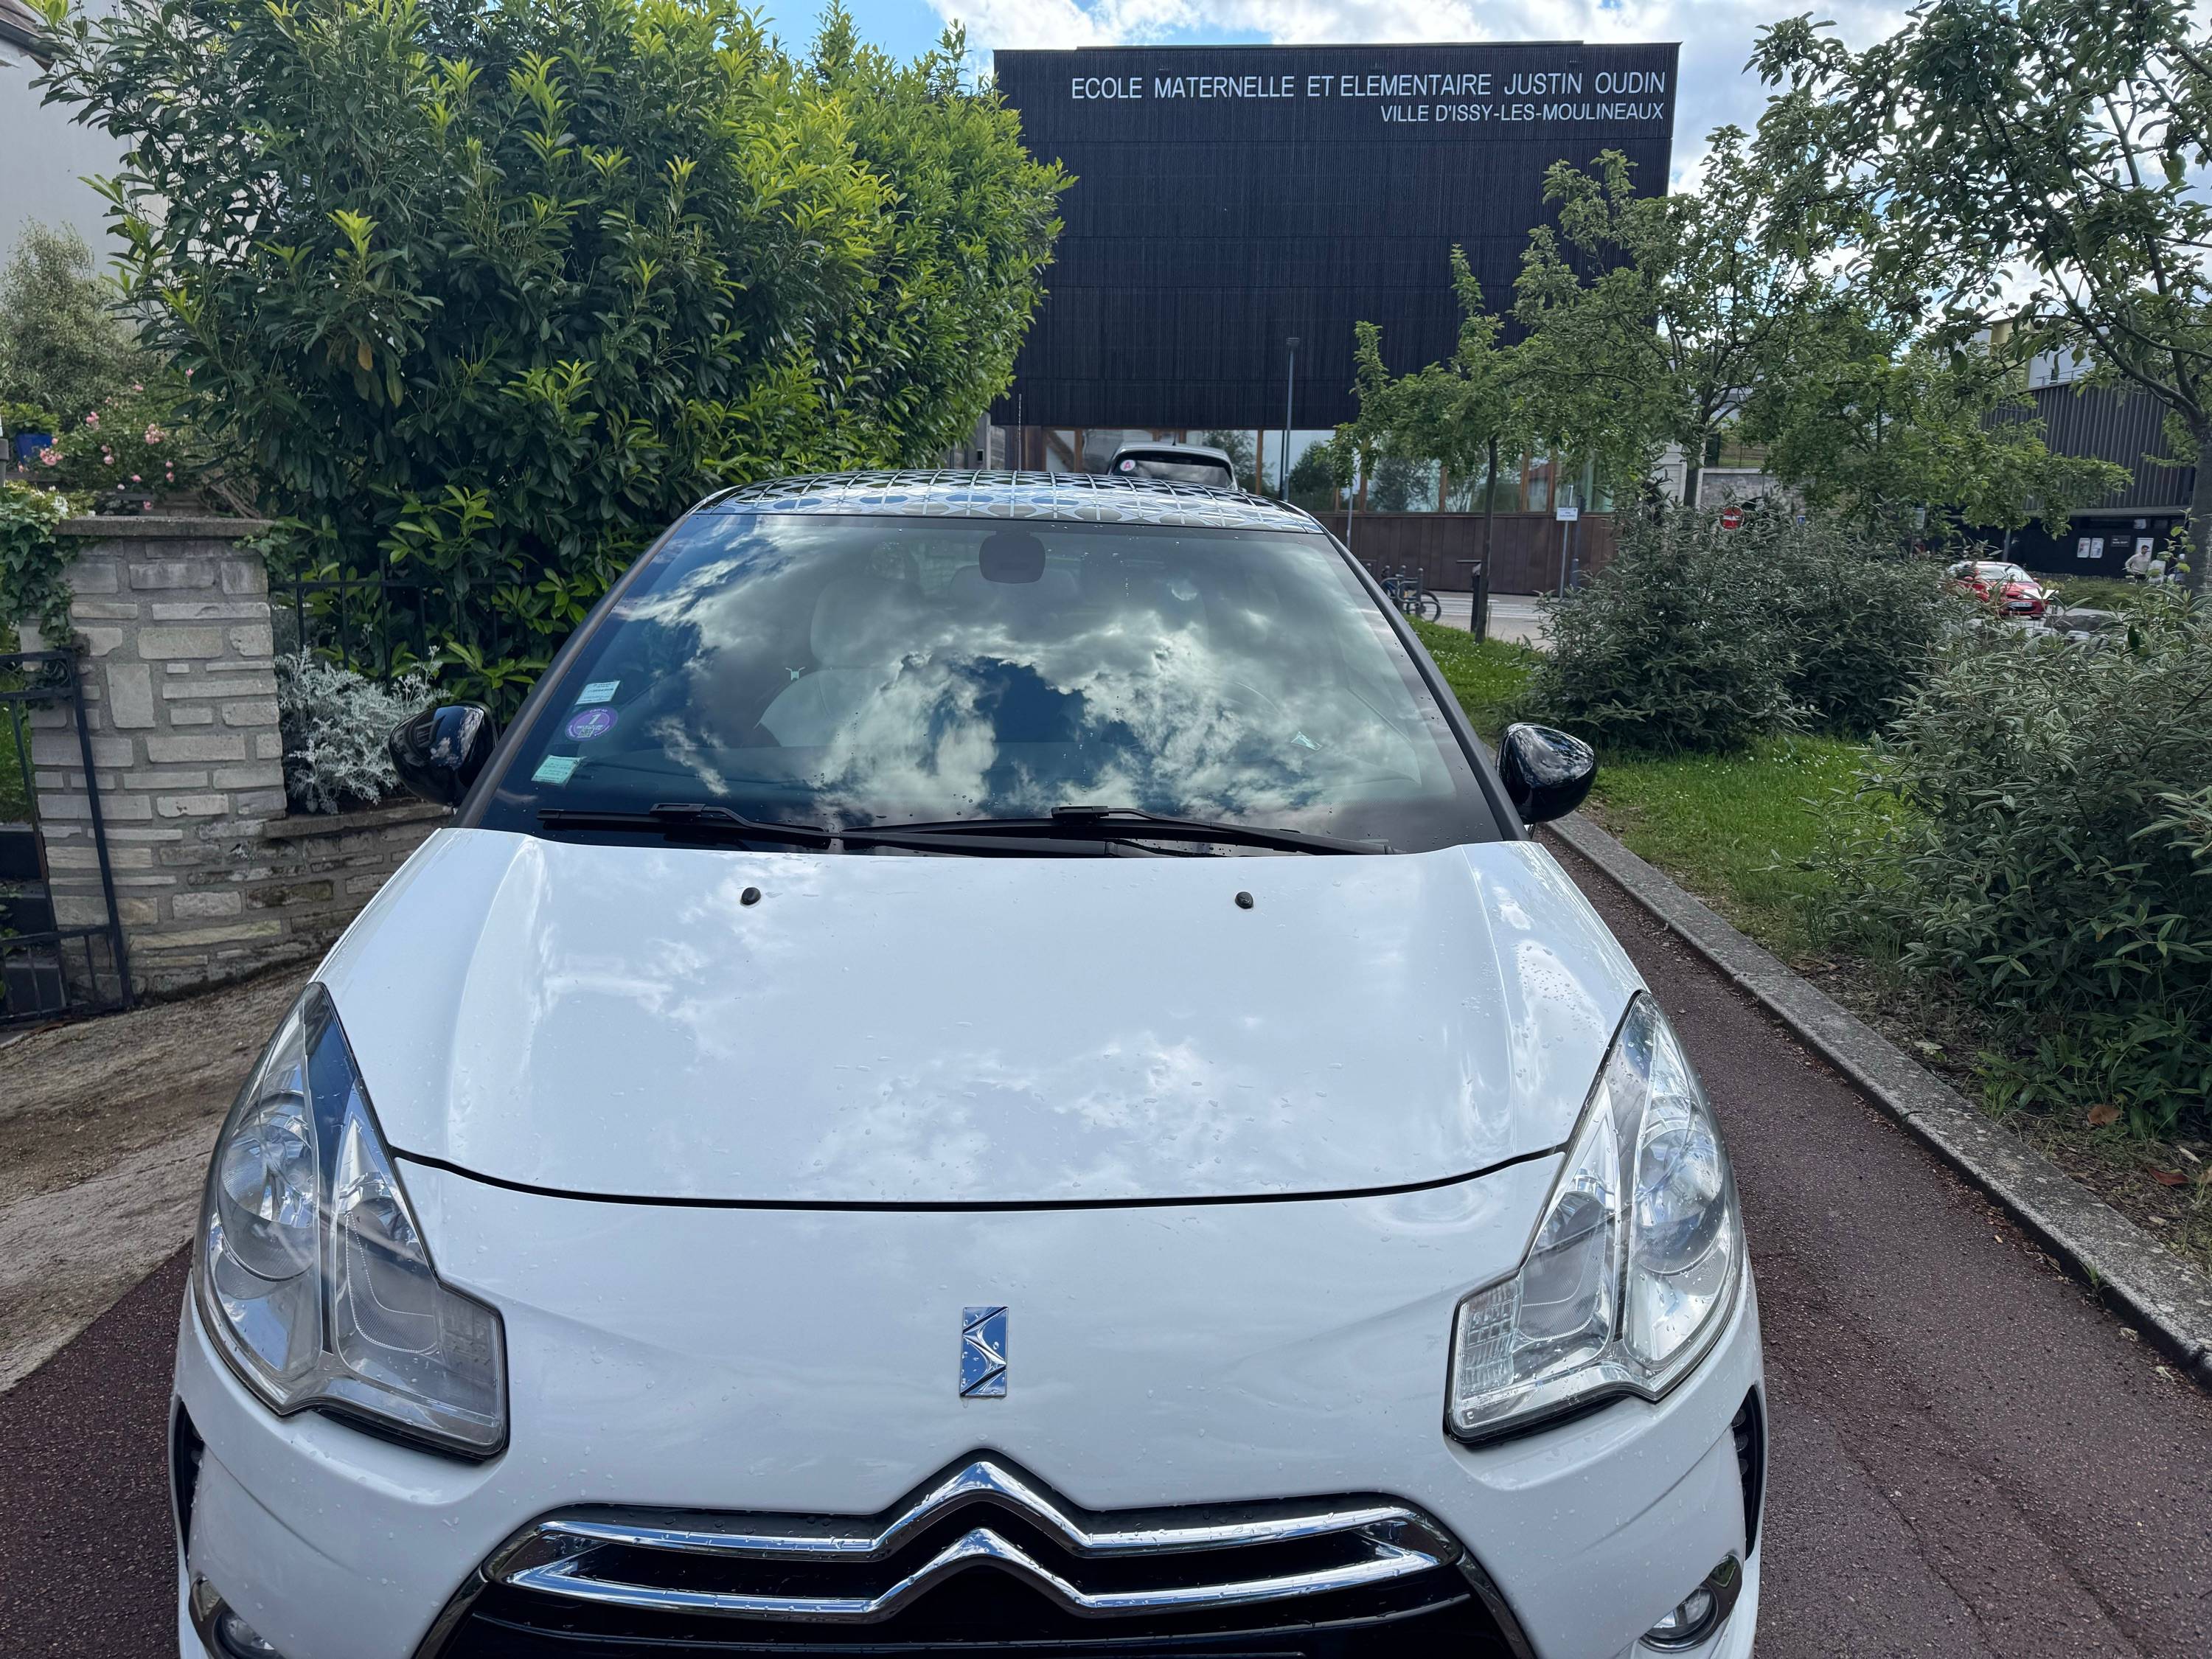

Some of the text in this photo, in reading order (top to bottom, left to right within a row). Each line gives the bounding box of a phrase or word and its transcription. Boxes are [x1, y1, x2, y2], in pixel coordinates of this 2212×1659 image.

[1072, 72, 1666, 100] ECOLE MATERNELLE ET ELEMENTAIRE JUSTIN OUDIN
[1380, 102, 1664, 122] VILLE D'ISSY-LES-MOULINEAUX
[1124, 461, 1132, 470] A
[588, 713, 602, 725] 1
